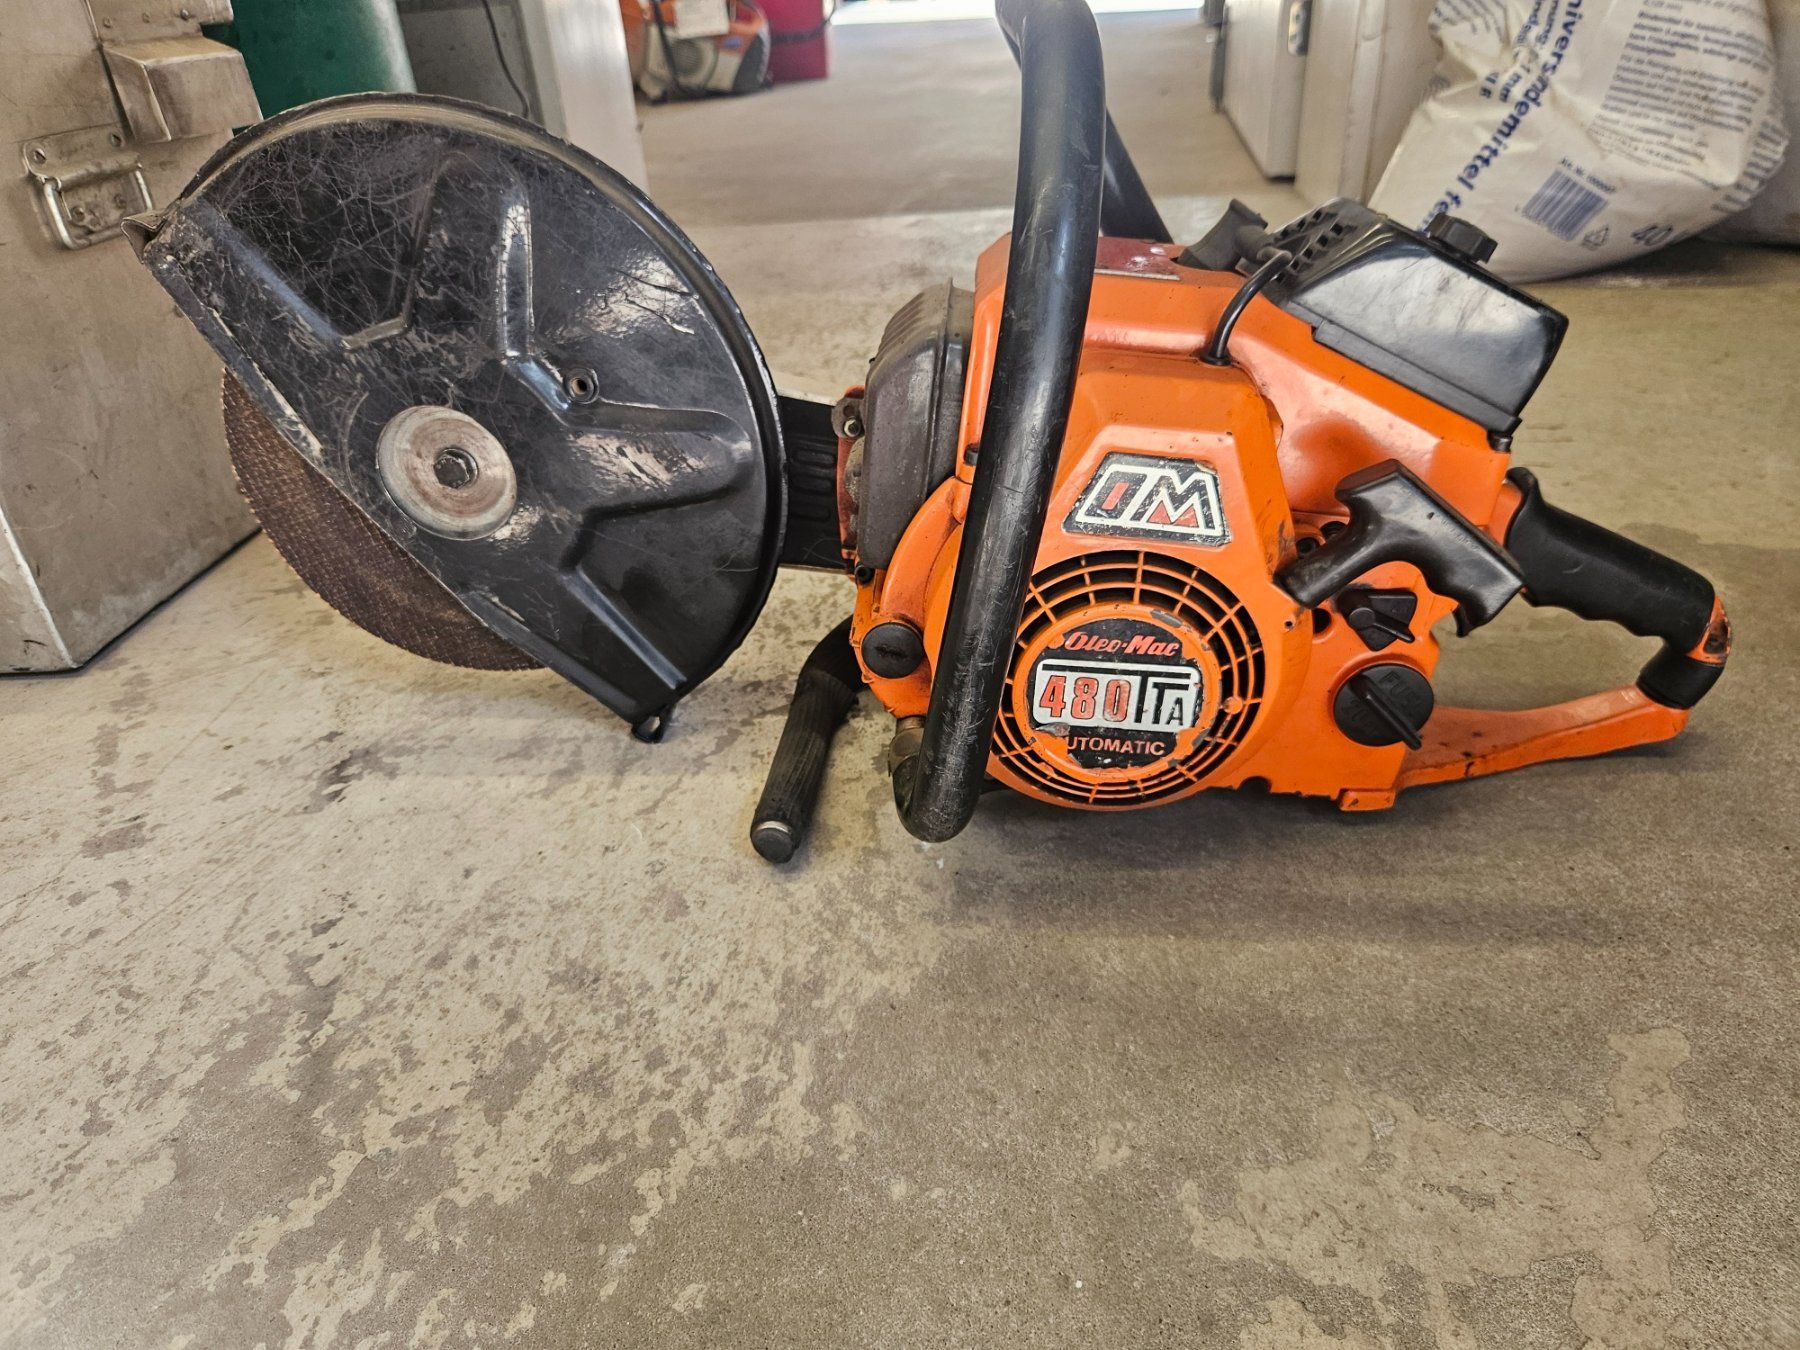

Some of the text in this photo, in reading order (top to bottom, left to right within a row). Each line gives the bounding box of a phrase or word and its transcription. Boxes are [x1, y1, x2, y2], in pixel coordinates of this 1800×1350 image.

[1063, 631, 1181, 658] Oleo-Mac
[1038, 674, 1132, 723] 480
[1066, 736, 1166, 756] UTOMATIC
